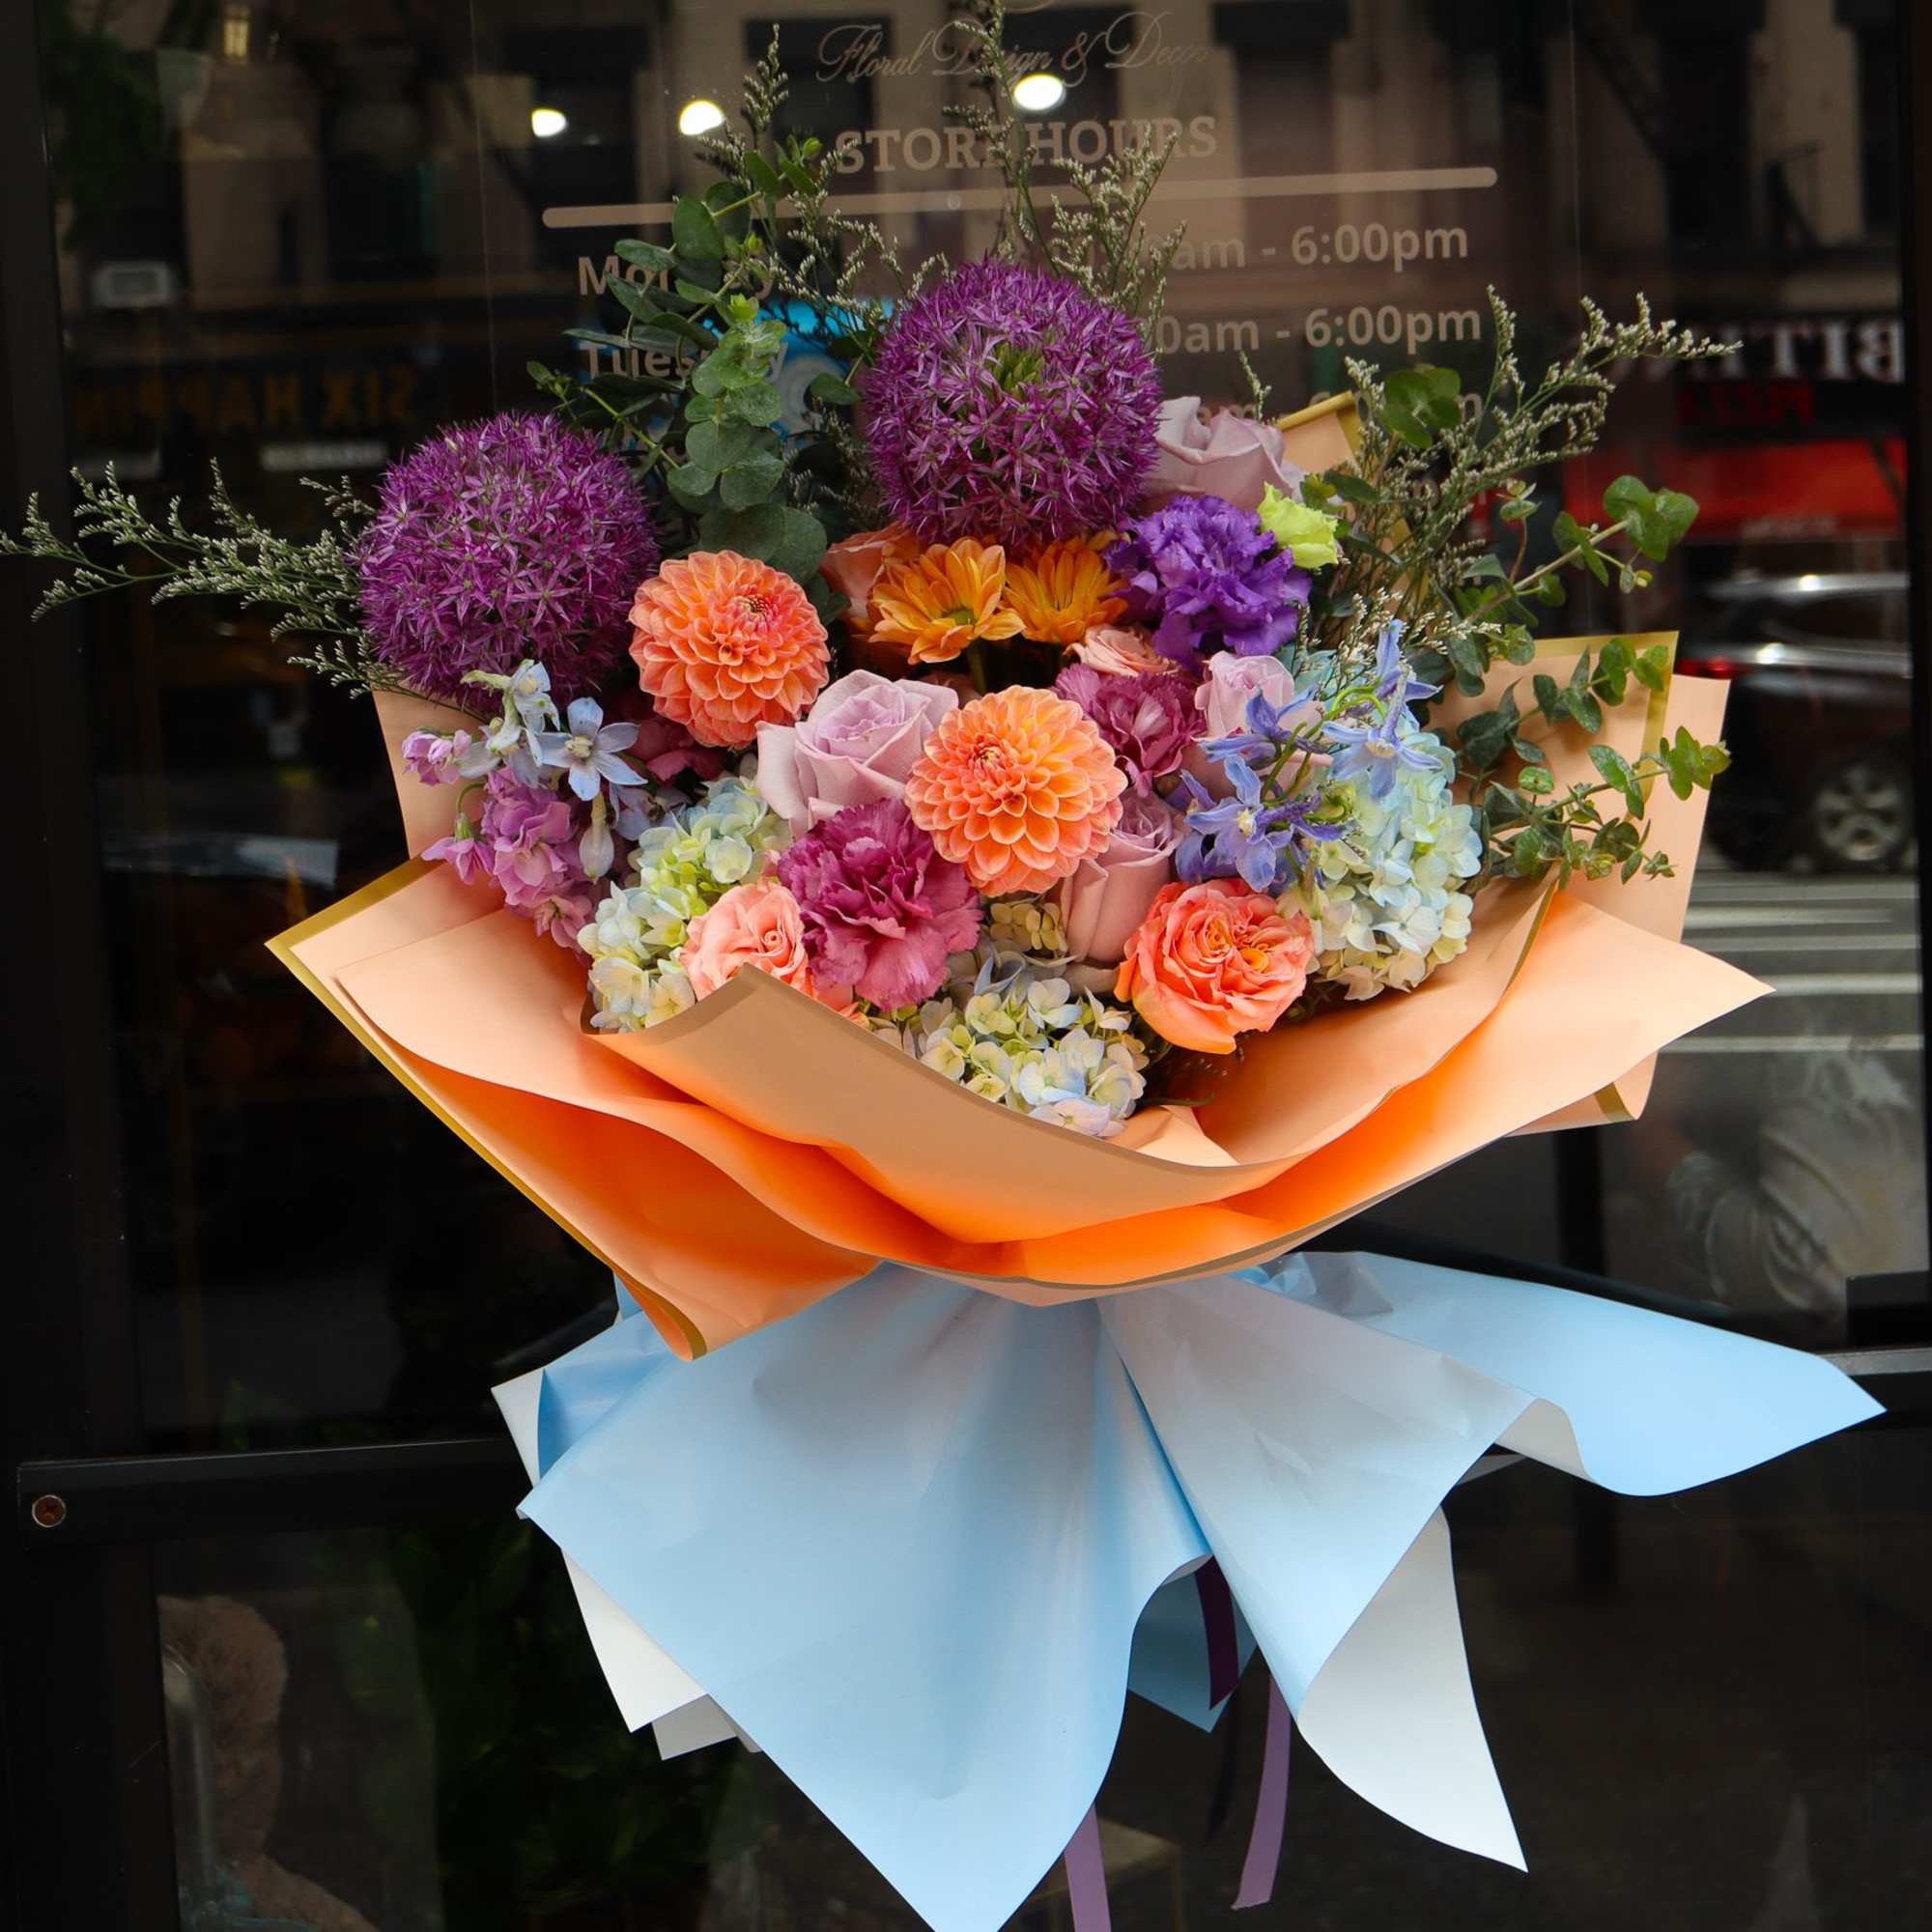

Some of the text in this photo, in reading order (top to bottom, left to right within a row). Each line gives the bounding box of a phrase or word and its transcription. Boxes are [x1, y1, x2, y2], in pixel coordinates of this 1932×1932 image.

[815, 24, 936, 83] Floral
[1063, 31, 1109, 87] &
[1024, 115, 1217, 166] HOURS
[1291, 223, 1469, 272] 6:00pm
[1304, 304, 1482, 355] 6:00pm
